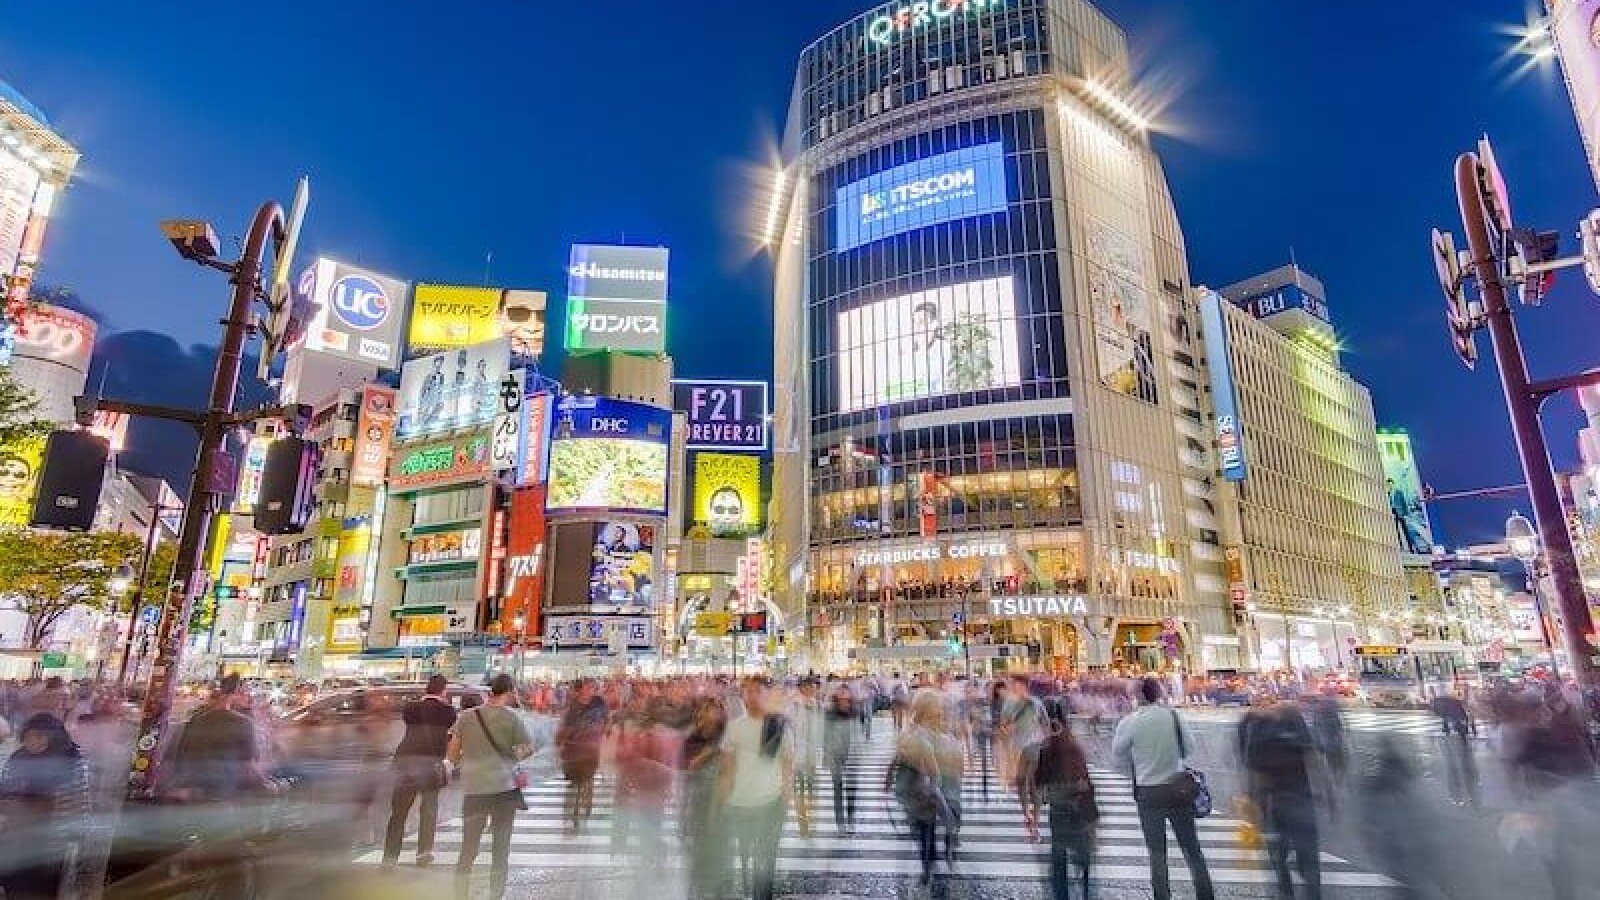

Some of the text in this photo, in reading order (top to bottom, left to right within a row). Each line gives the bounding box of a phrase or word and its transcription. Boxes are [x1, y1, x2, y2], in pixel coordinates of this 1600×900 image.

[870, 0, 1004, 44] QFRO
[570, 312, 660, 335] サロンパス
[691, 387, 743, 421] F21
[591, 417, 629, 433] DHC
[745, 425, 761, 441] 21
[855, 543, 1008, 566] STARBUCKS COFFEE
[990, 597, 1088, 616] TSUTAYA
